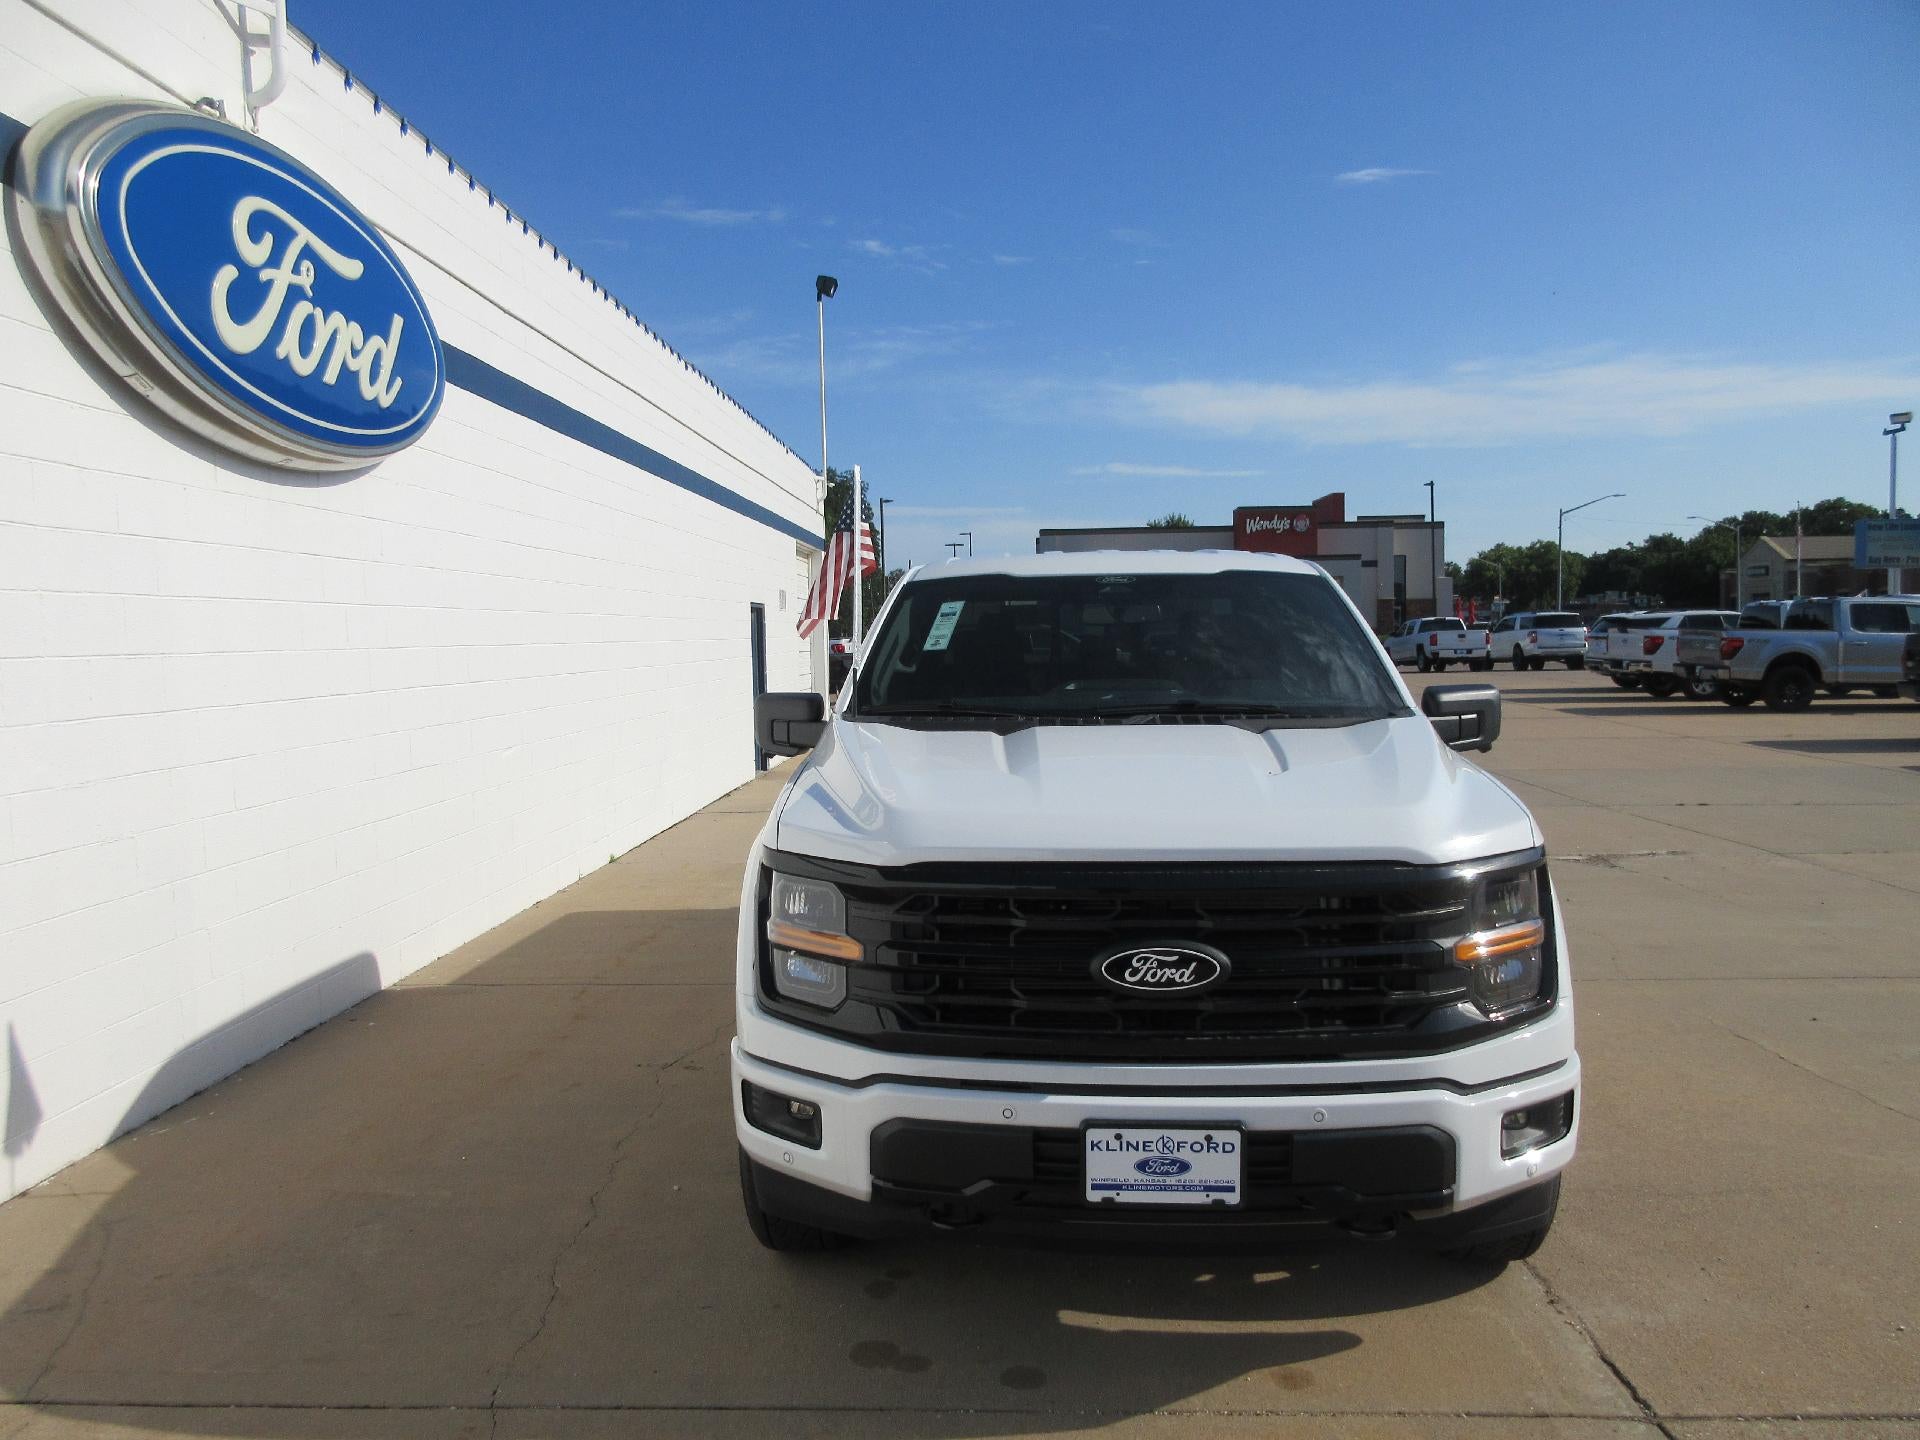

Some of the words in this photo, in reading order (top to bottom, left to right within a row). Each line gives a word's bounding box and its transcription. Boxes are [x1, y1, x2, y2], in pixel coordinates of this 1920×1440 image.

[211, 195, 404, 409] Ford
[1246, 514, 1290, 534] Wendy's
[1125, 953, 1197, 982] Ford
[1090, 1139, 1154, 1152] KLINE
[1177, 1141, 1235, 1154] FORD
[1146, 1159, 1180, 1173] Ford
